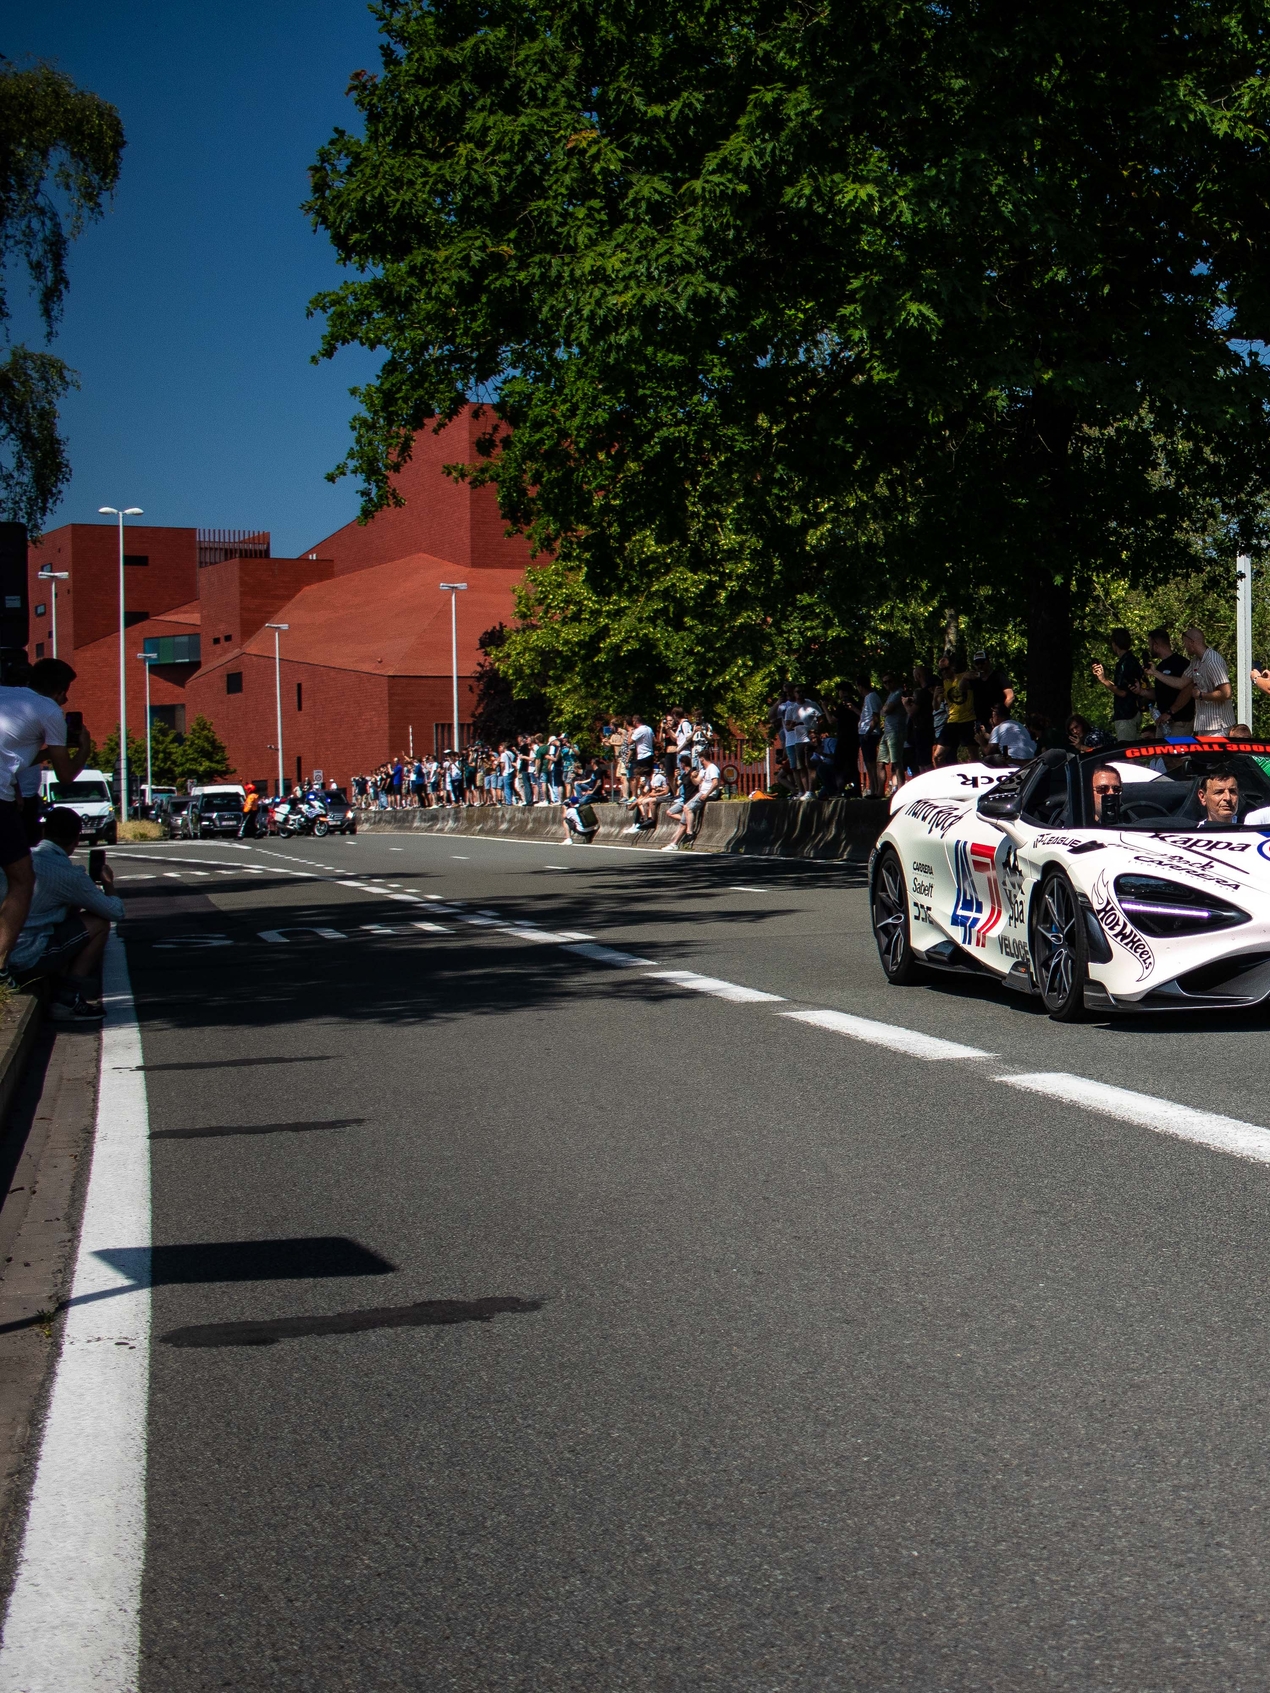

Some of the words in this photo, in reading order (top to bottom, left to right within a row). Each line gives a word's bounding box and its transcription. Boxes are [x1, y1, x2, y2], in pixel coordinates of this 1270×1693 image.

[1125, 743, 1224, 758] GUMBALL
[1149, 832, 1251, 852] Kappa
[912, 861, 934, 876] CARRERA
[912, 877, 935, 898] Sabelt
[998, 934, 1031, 960] VELOCE
